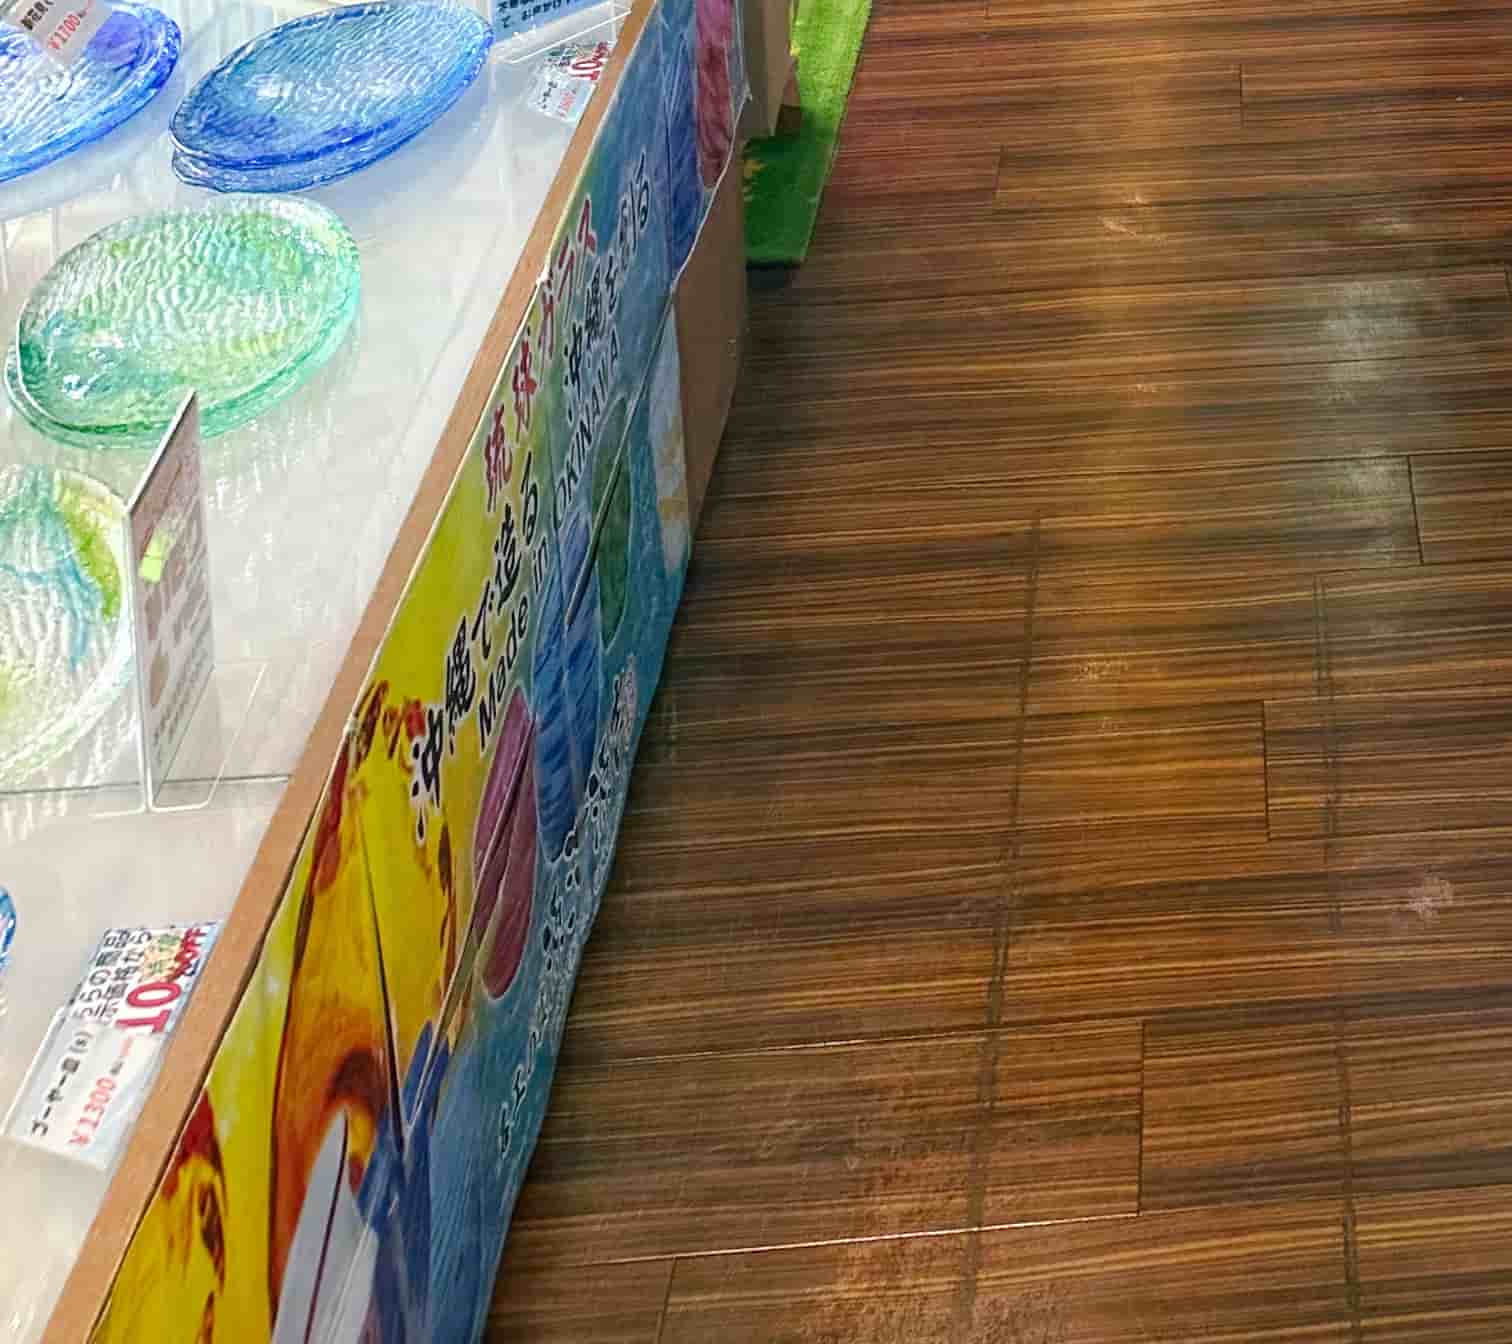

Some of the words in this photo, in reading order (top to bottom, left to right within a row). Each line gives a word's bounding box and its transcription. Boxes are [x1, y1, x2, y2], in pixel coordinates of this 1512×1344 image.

[476, 592, 531, 749] Made
[531, 533, 549, 593] in
[551, 327, 619, 529] OKINAWA
